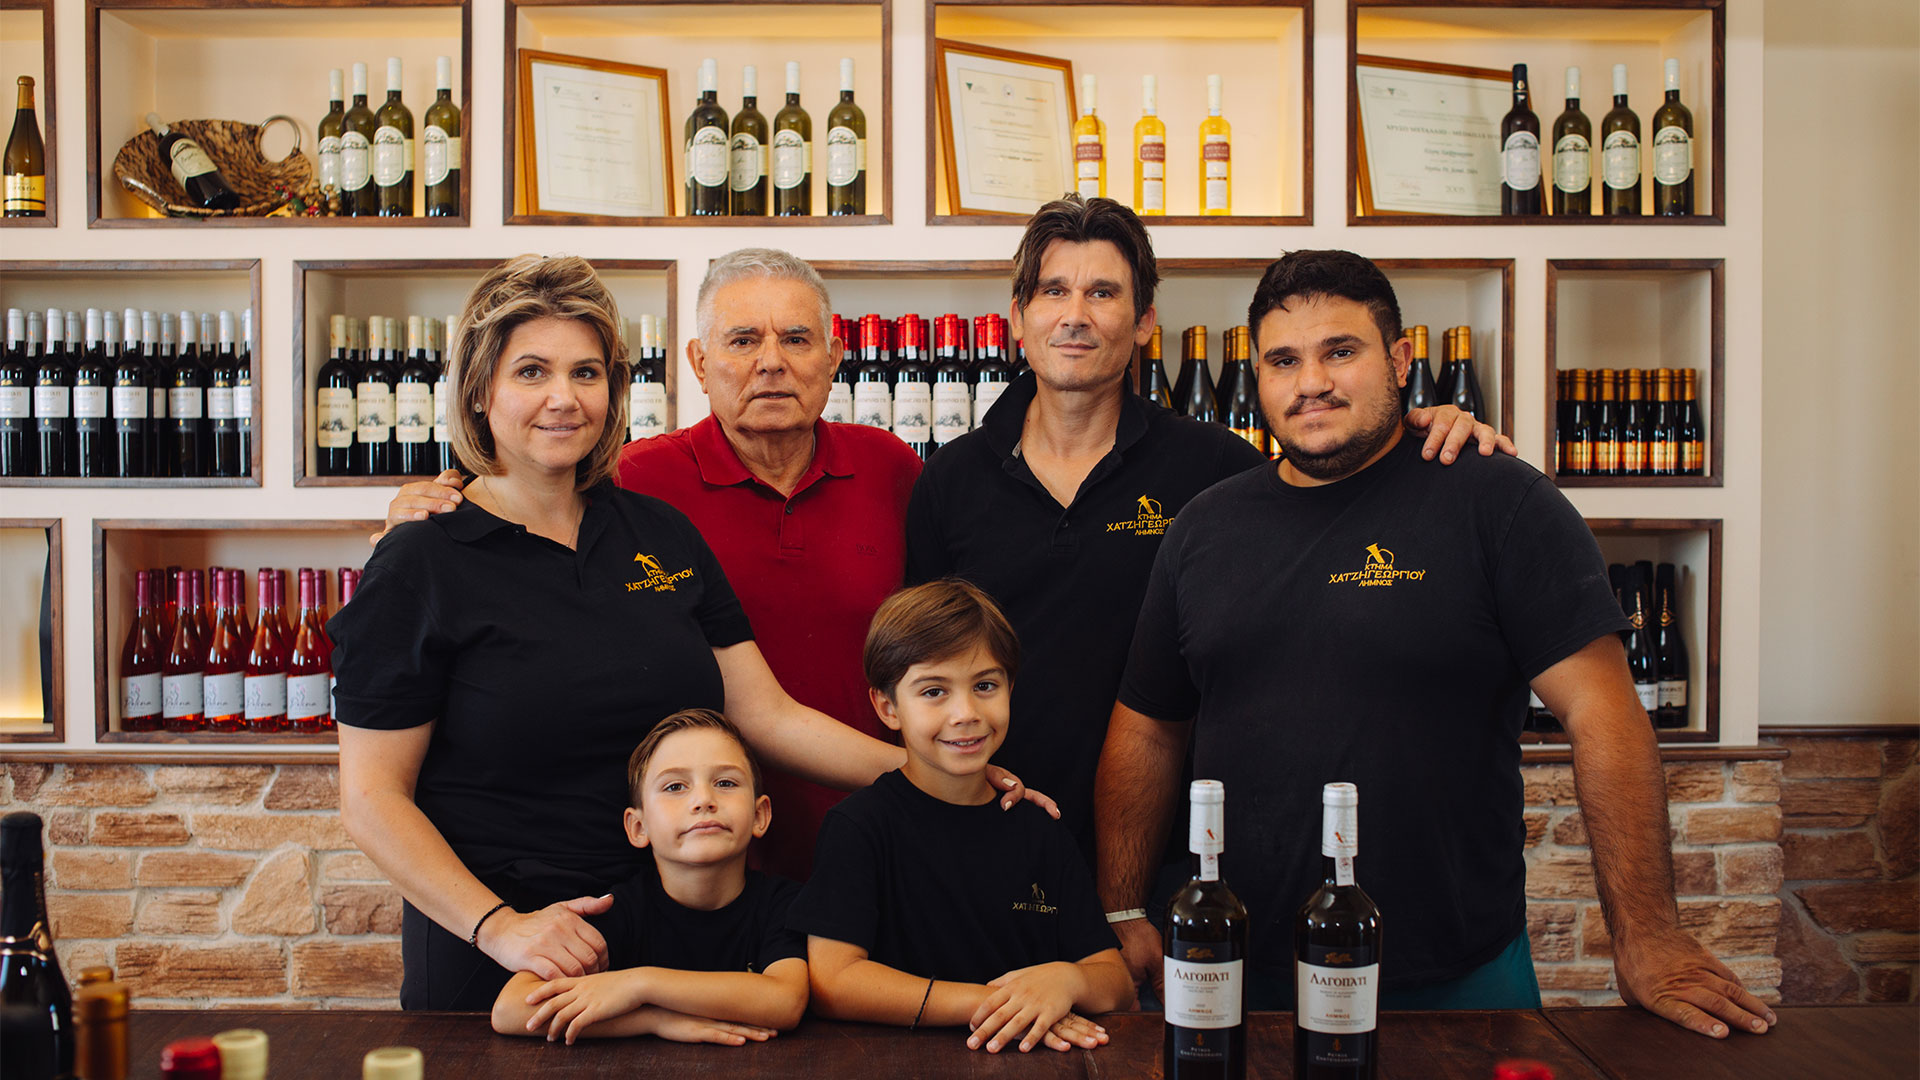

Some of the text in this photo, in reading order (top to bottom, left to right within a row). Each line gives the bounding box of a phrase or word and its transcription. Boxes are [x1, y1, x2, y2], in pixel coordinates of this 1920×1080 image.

[1137, 513, 1163, 521] ΚΤΗΜΑ
[1106, 517, 1176, 532] ΧΑΤΖΗΓΕΩΡΓ
[1134, 528, 1165, 536] ΛΗΜΝΟΣ
[1328, 569, 1426, 584] ΧΑΤΖΗΓΕΩΡΓΙΟΥ
[1358, 579, 1394, 587] ΛΗΜΝΟΣ
